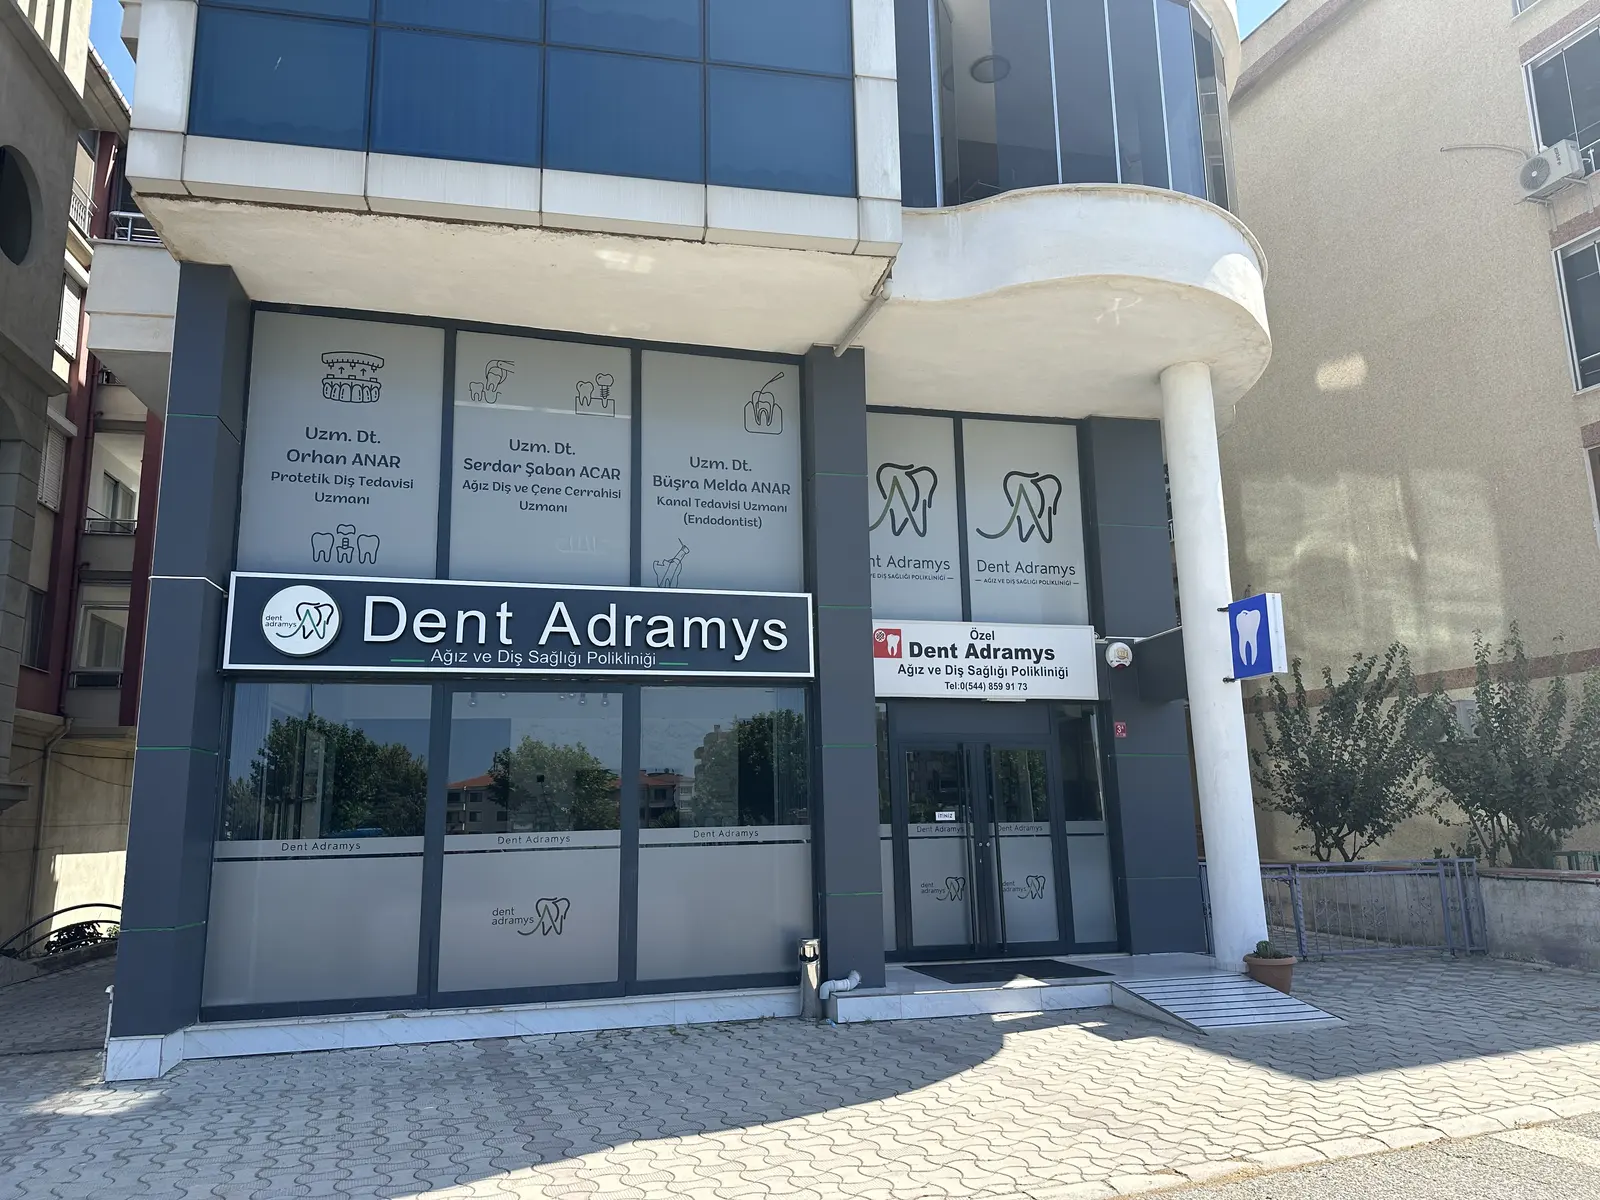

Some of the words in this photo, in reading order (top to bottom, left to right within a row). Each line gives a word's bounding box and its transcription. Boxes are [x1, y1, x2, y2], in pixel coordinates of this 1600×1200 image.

[305, 426, 352, 442] Uzm.
[356, 430, 381, 444] Dt.
[509, 438, 550, 454] Uzm.
[555, 442, 576, 456] Dt.
[286, 449, 347, 465] Orhan
[352, 453, 401, 469] ANAR
[689, 456, 728, 471] Uzm.
[732, 458, 752, 472] Dt.
[463, 458, 521, 473] Serdar
[525, 461, 575, 479] Şaban
[579, 466, 621, 480] ACAR
[271, 471, 330, 485] Protetik
[334, 474, 355, 488] Diş
[359, 475, 414, 489] Tedavisi
[652, 474, 700, 492] Büşra
[703, 478, 748, 493] Melda
[751, 481, 791, 495] ANAR
[462, 479, 489, 491] Ağız
[492, 481, 512, 495] Diş
[514, 485, 528, 493] ve
[531, 484, 562, 496] Çene
[564, 486, 621, 499] Cerrahisi
[314, 492, 370, 505] Uzmanı
[657, 496, 692, 509] Kanal
[695, 497, 741, 511] Tedavisi
[743, 500, 788, 513] Uzmanı
[519, 501, 568, 513] Uzmanı
[683, 512, 762, 528] (Endodontist)
[887, 555, 950, 573] Adramys
[977, 559, 1010, 573] Dent
[1015, 561, 1076, 578] Adramys
[363, 594, 514, 646] Dent
[538, 600, 788, 661] Adramys
[970, 627, 995, 641] Özel
[430, 648, 467, 667] Ağız
[473, 651, 492, 663] ve
[498, 650, 523, 667] Diş
[527, 650, 582, 666] Sağlığı
[586, 652, 656, 668] Polikliniği
[909, 642, 958, 659] Dent
[965, 642, 1055, 664] Adramys
[898, 664, 924, 676] Ağız
[927, 666, 941, 675] ve
[945, 665, 963, 678] Diş
[967, 665, 1008, 678] Sağlığı
[1012, 666, 1068, 679] Polikliniği
[944, 681, 986, 692] Tel:0(544)
[988, 682, 1003, 691] 859
[1005, 682, 1015, 691] 91
[1017, 683, 1028, 691] 73
[694, 830, 716, 838] Dent
[719, 829, 759, 838] Adramys
[935, 825, 964, 834] Adramys
[281, 841, 307, 851] Dent
[312, 841, 361, 852] Adramys
[497, 835, 521, 844] Dent
[526, 833, 570, 845] Adramys
[492, 907, 514, 916] dent
[492, 916, 534, 926] adramys
